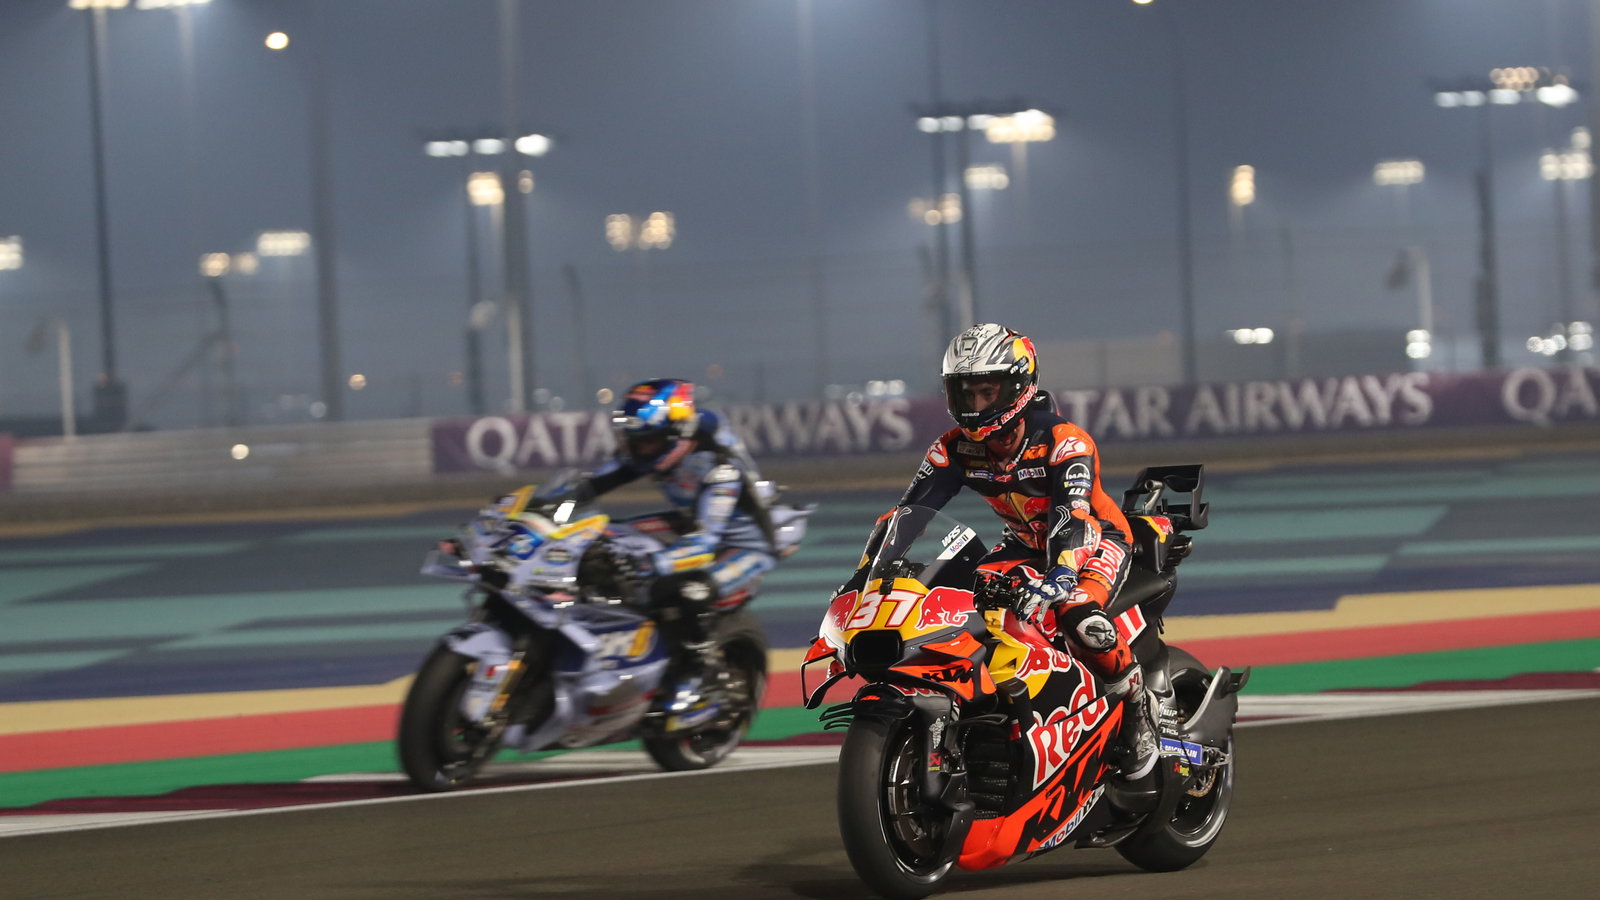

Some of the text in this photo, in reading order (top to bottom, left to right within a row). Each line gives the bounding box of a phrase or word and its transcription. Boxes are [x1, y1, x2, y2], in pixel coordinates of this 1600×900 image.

[1062, 372, 1433, 440] TAR AIRWAYS
[1501, 366, 1600, 426] QA
[465, 398, 913, 475] QATA RWAYS
[846, 589, 926, 631] 37
[921, 664, 976, 684] KTM
[1028, 658, 1109, 790] Red
[1043, 809, 1082, 849] Mobil
